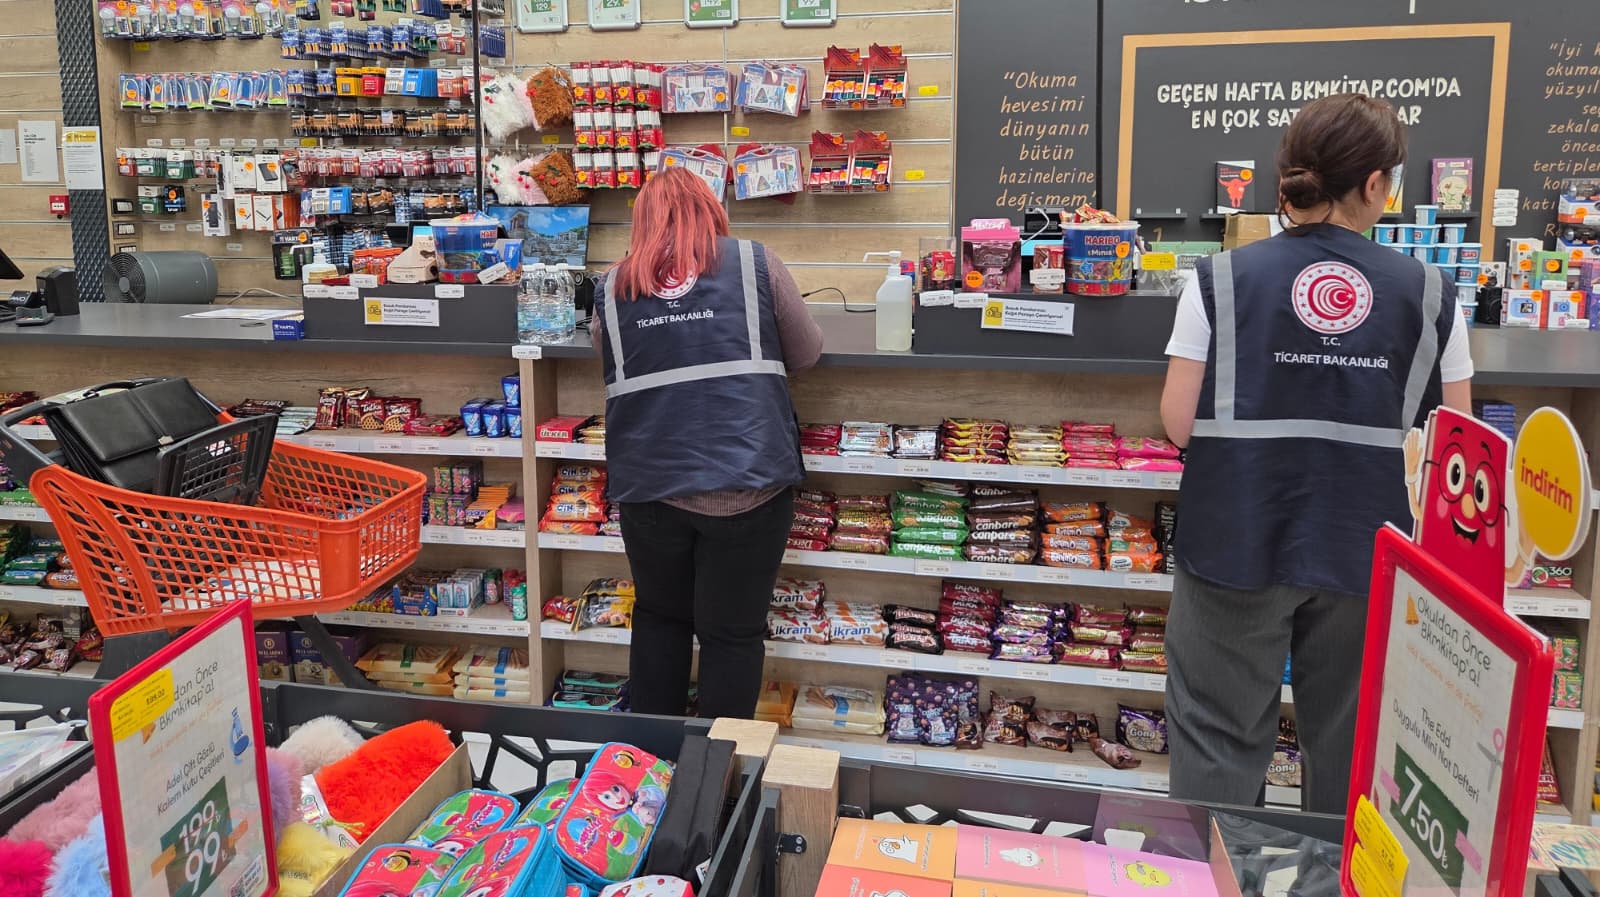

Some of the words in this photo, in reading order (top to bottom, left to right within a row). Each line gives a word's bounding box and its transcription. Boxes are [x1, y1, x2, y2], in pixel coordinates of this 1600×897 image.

[1157, 83, 1218, 108] GEÇEN
[1225, 80, 1285, 102] HAFTA
[1544, 80, 1600, 99] yüzyıl
[1000, 96, 1085, 114] hevesimi
[1000, 121, 1090, 141] dünyanın
[1191, 110, 1217, 129] EN
[1222, 109, 1261, 133] ÇOK
[1548, 119, 1600, 134] zekala
[1019, 143, 1075, 161] bütün
[999, 166, 1096, 184] hazinelerine
[1085, 235, 1121, 246] HARIBO
[666, 301, 681, 309] T.C.
[636, 315, 669, 329] TİCARET
[670, 309, 714, 322] BAKANLIĞI
[1319, 336, 1341, 347] T.C.
[1274, 352, 1322, 364] TİCARET
[1323, 355, 1389, 369] BAKANLIĞI
[1521, 458, 1574, 514] indirim
[771, 594, 804, 603] kram
[1417, 596, 1458, 642] Okuldan
[1462, 630, 1491, 670] Önce
[1420, 622, 1481, 688] Bkmkitap'a!
[195, 661, 218, 684] Önce
[1129, 727, 1156, 740] Gong
[1421, 707, 1435, 732] The
[1436, 723, 1452, 748] Edd
[1393, 698, 1421, 739] Duygulu
[1422, 731, 1438, 757] Mini
[1439, 747, 1452, 770] Not
[1452, 763, 1480, 803] Defteri
[166, 774, 183, 793] Adel
[183, 760, 197, 777] Çift
[196, 742, 215, 766] Gözlü
[158, 791, 182, 816] Kalem
[182, 777, 199, 795] Kutu
[198, 748, 225, 779] Çeşitleri
